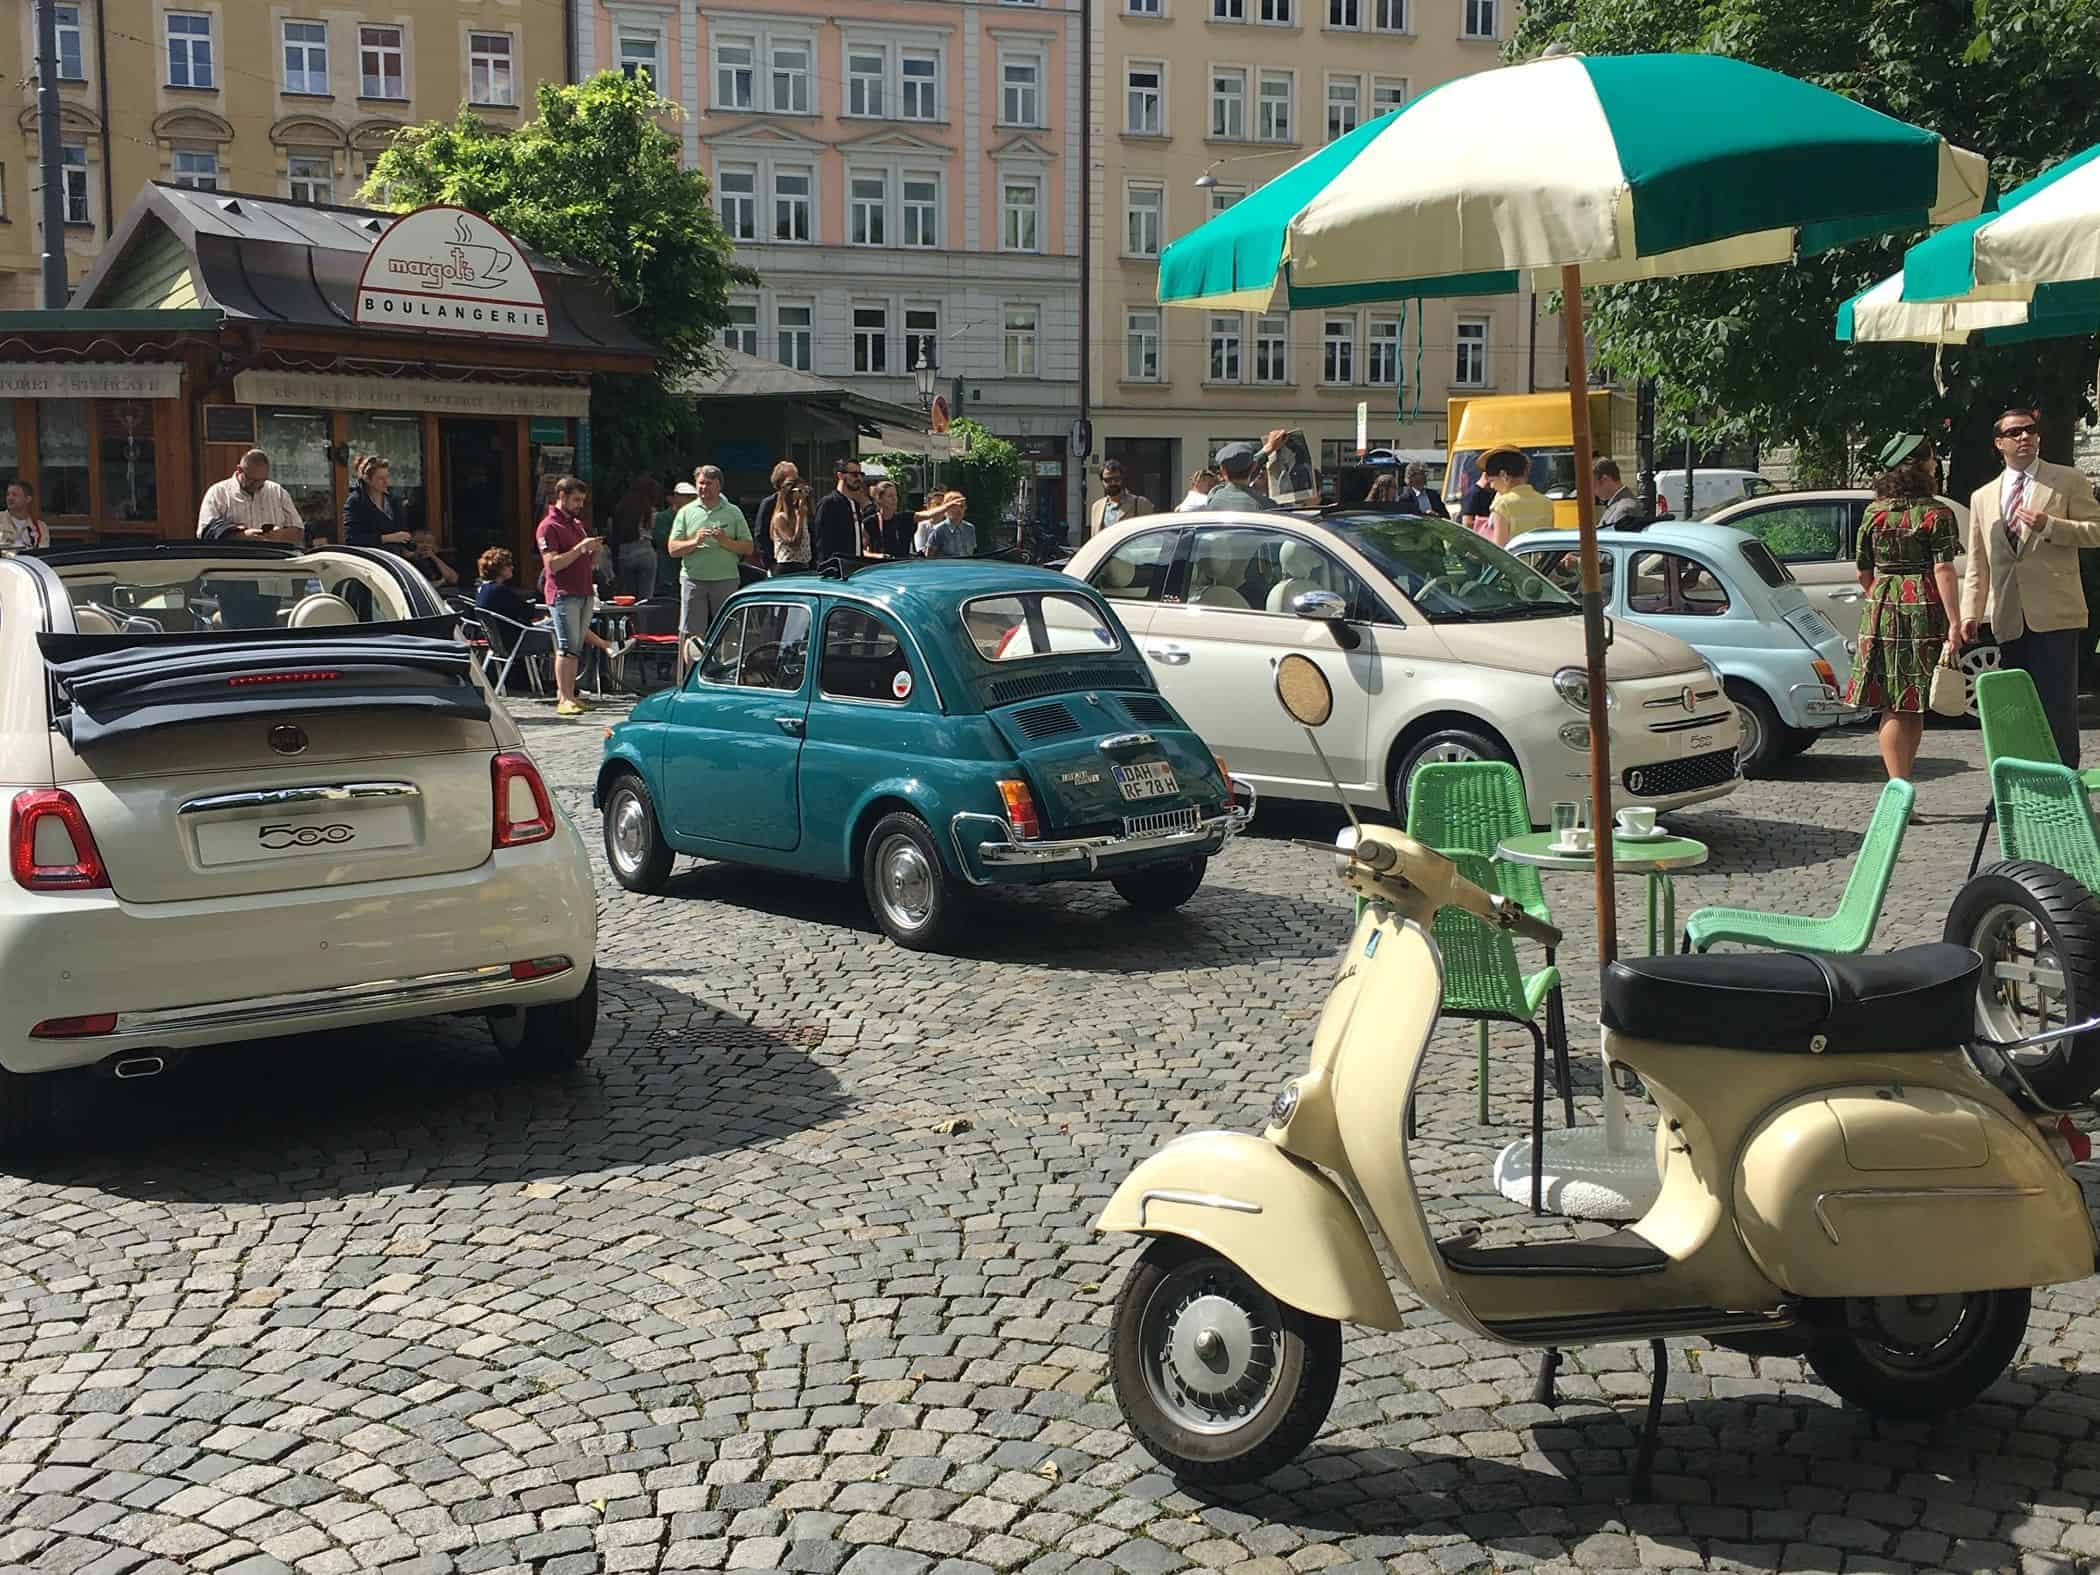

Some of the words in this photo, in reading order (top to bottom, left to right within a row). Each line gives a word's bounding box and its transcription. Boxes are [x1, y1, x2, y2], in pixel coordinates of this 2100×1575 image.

[388, 247, 475, 289] margot's
[364, 298, 546, 326] BOULANGERIE
[1123, 765, 1153, 781] DAH
[1124, 782, 1144, 798] RF
[258, 823, 356, 850] 500
